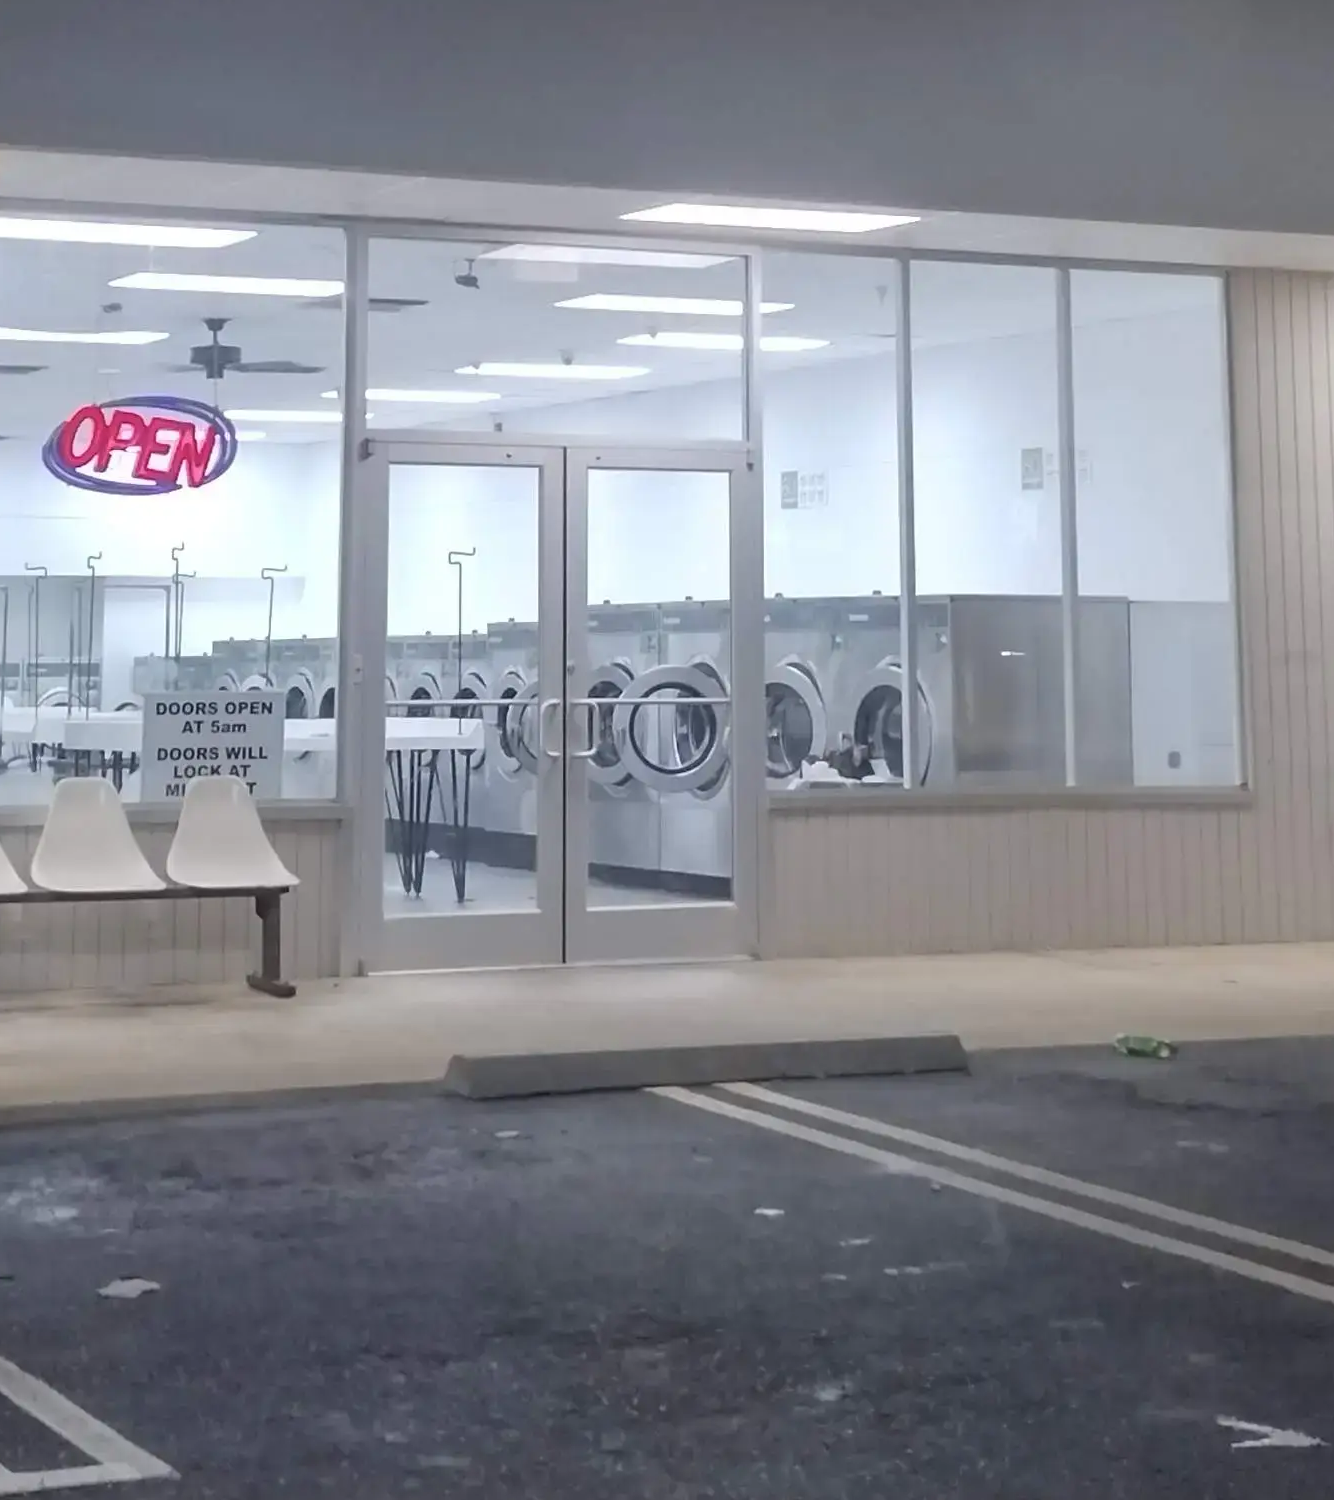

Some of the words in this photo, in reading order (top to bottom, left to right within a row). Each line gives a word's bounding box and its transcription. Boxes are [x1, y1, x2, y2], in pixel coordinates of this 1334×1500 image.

[58, 404, 217, 488] OPEN
[155, 701, 219, 716] DOORS
[224, 701, 273, 715] OPEN
[181, 720, 205, 734] AT
[210, 720, 247, 734] 5am
[156, 746, 220, 761] DOORS
[225, 746, 268, 760] WILL
[173, 764, 222, 779] LOCK
[228, 764, 252, 778] AT
